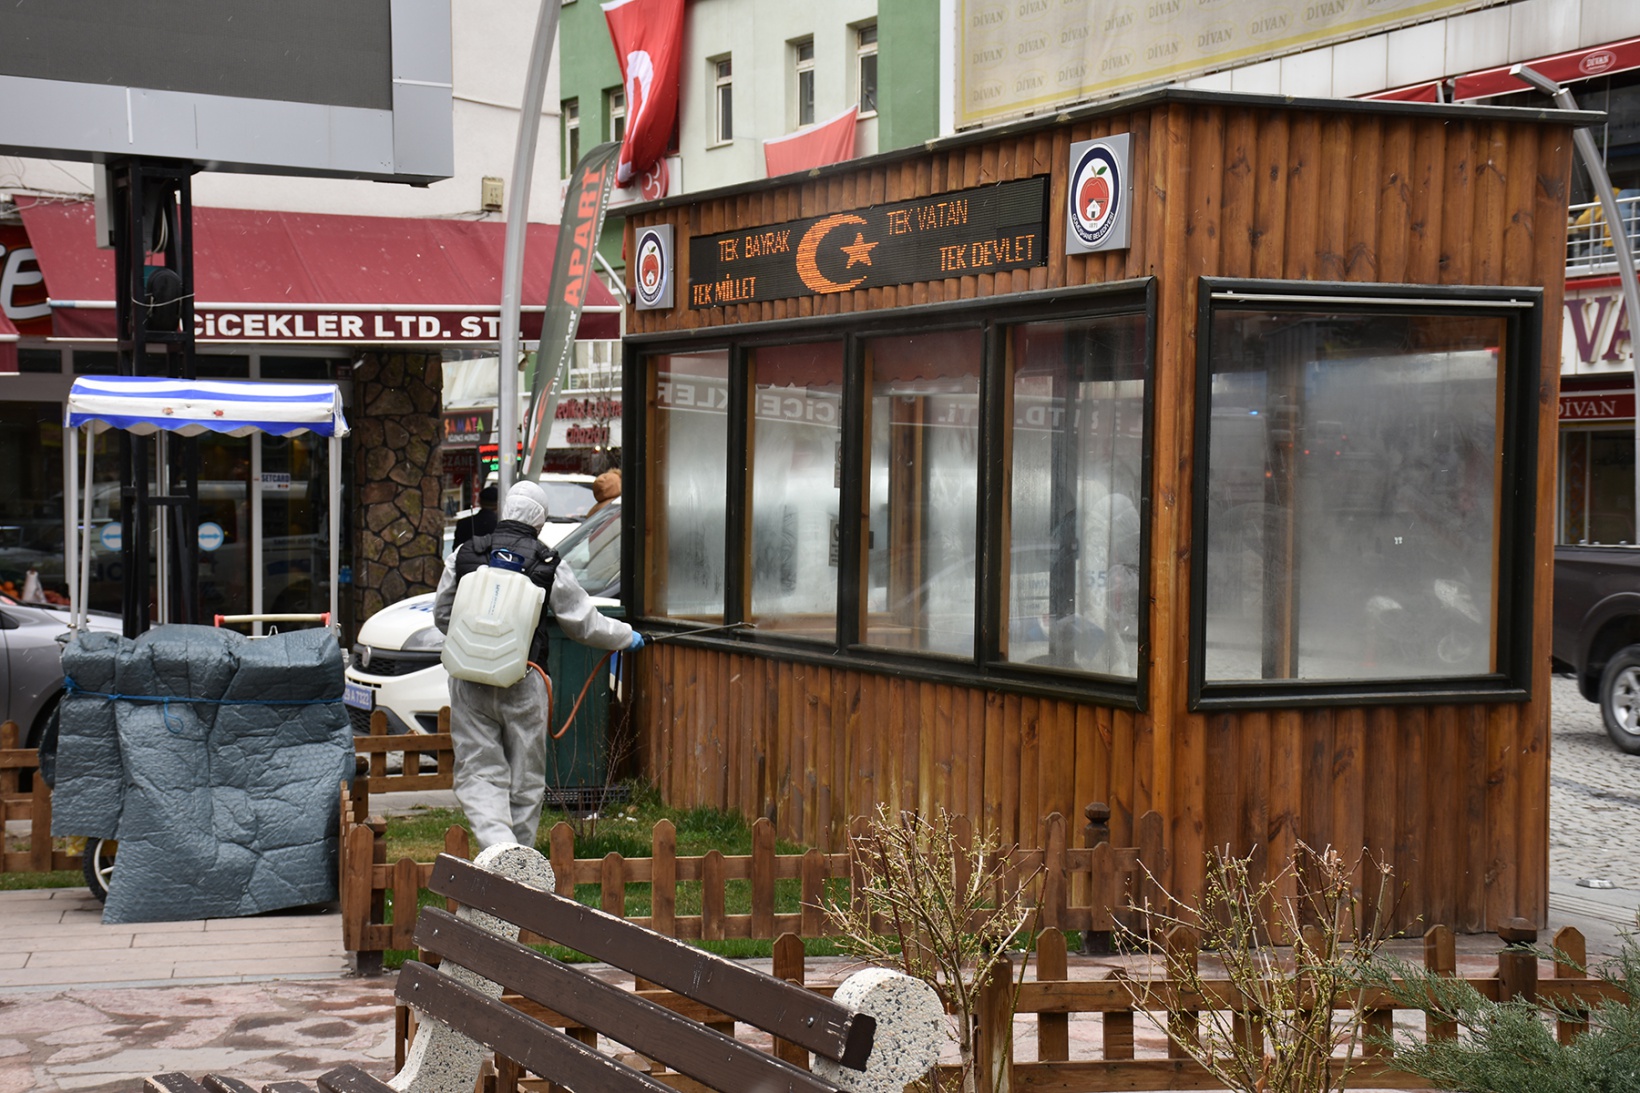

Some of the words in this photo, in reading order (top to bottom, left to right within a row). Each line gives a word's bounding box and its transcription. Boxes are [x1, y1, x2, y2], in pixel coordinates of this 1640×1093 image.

[886, 208, 913, 235] TEK
[917, 199, 968, 230] VATAN
[564, 166, 600, 307] APART
[718, 238, 739, 262] TEK
[745, 230, 790, 258] BAYRAK
[939, 244, 967, 271] TEK
[972, 234, 1035, 268] DEVLET
[693, 283, 713, 305] TEK
[715, 274, 756, 302] MİLLET
[375, 316, 451, 337] LTD.
